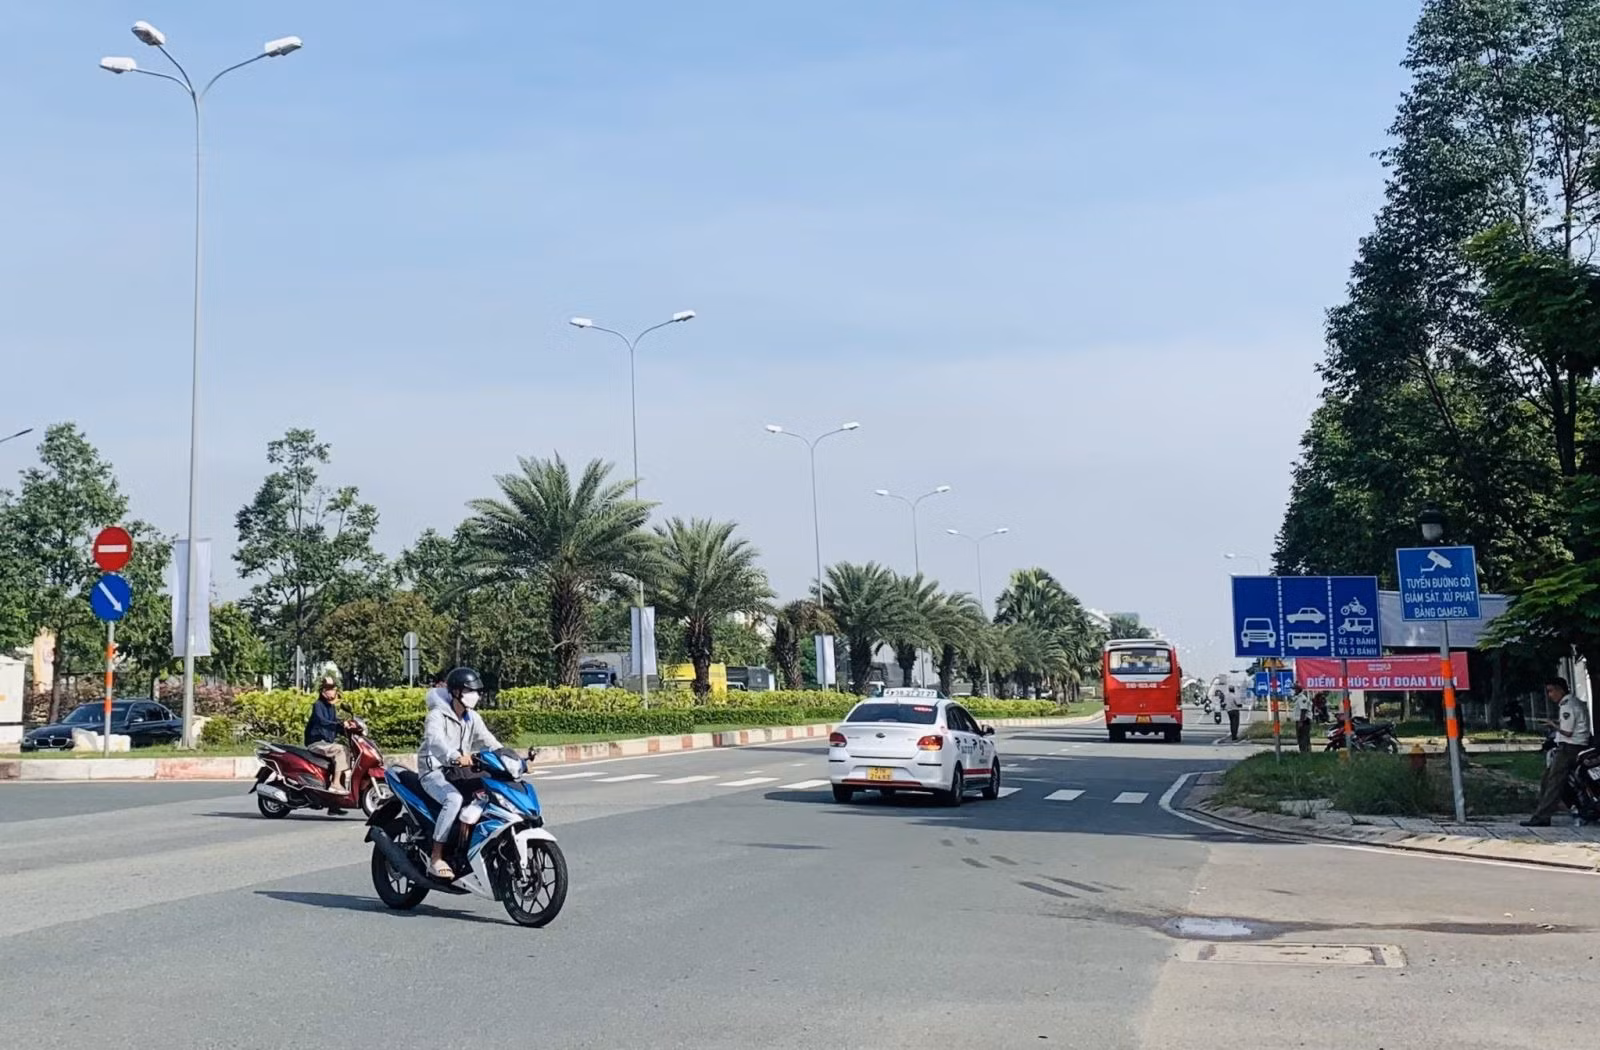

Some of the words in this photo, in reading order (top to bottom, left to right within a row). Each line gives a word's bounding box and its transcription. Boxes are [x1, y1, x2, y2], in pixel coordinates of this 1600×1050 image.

[1406, 574, 1431, 588] TUYẾN
[1432, 574, 1459, 588] ĐƯỜNG
[1460, 574, 1471, 588] CÓ
[1404, 590, 1424, 603] GIÁM
[1442, 588, 1454, 602] XỬ
[1455, 591, 1475, 605] PHẠT
[1414, 604, 1436, 618] BẰNG
[1437, 606, 1469, 617] CAMERA
[1338, 637, 1348, 645] XE
[1349, 637, 1355, 645] 2
[1338, 646, 1349, 655] VÀ
[1349, 647, 1355, 655] 3
[1306, 673, 1336, 687] ĐIỂM
[1372, 675, 1391, 688] LỢI
[1394, 674, 1427, 687] ĐOÀN
[1429, 675, 1458, 687] VIN
